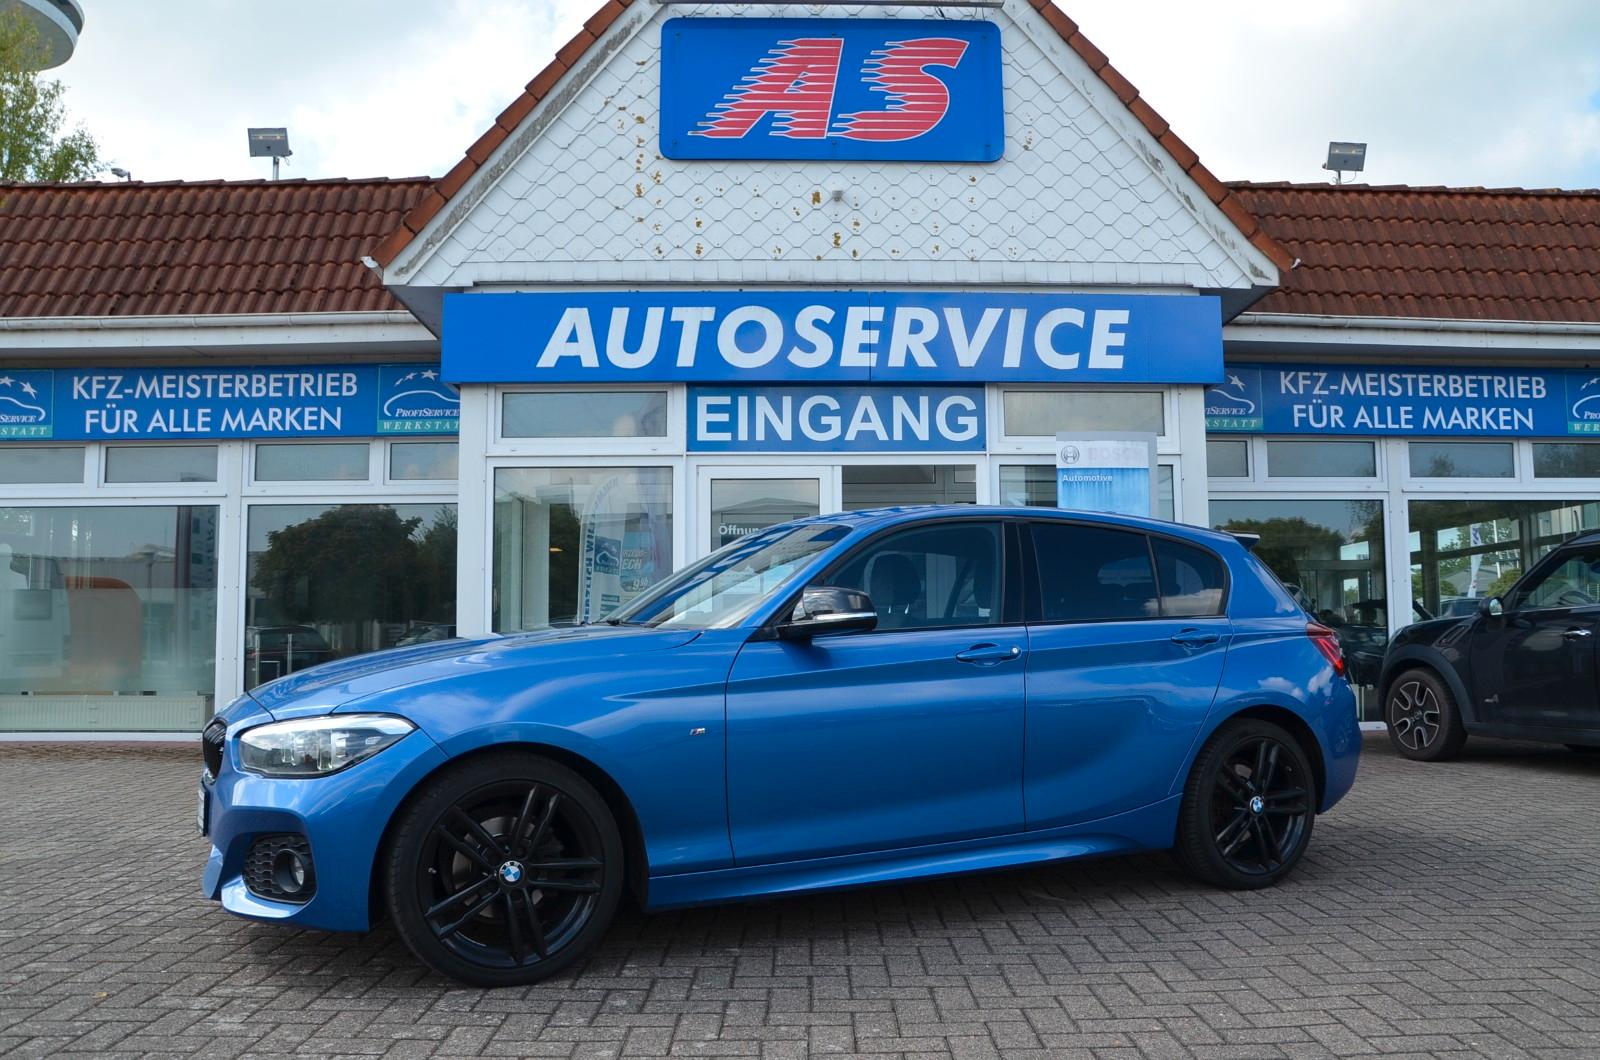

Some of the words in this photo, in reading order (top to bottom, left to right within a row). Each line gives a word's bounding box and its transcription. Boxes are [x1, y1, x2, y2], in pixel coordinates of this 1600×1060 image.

[688, 38, 970, 142] AS
[536, 305, 1131, 370] AUTOSERVICE
[73, 373, 358, 400] KFZ-MEISTERBETRIEB
[1280, 371, 1547, 399] KFZ-MEISTERBETRIEB
[85, 403, 139, 433] FÜR
[146, 408, 211, 433] ALLE
[220, 406, 341, 432] MARKEN
[697, 395, 979, 442] EINGANG
[1293, 399, 1346, 428] FÜR
[1353, 405, 1413, 429] ALLE
[1423, 405, 1533, 430] MARKEN
[1062, 474, 1113, 482] Automotive
